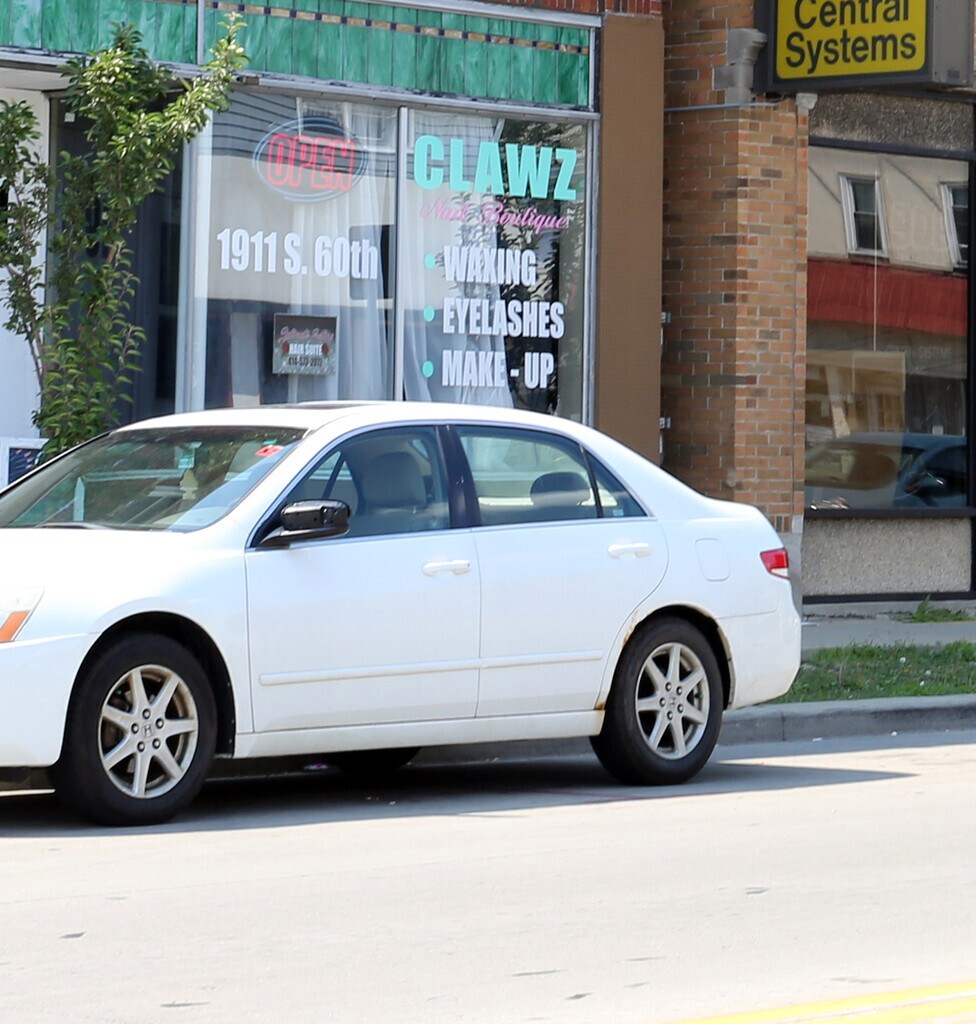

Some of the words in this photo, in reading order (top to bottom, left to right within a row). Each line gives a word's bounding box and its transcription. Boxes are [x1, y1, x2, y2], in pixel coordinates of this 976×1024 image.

[785, 29, 917, 74] Systems
[267, 133, 356, 192] OPEN
[414, 135, 577, 201] CLAWZ
[477, 199, 567, 235] Boutique
[217, 228, 277, 273] 1911
[283, 232, 307, 275] S.
[314, 235, 378, 280] 60th
[443, 245, 537, 287] WAXING
[443, 297, 565, 339] EYELASHES
[442, 349, 506, 388] MAKE
[524, 352, 554, 389] UP
